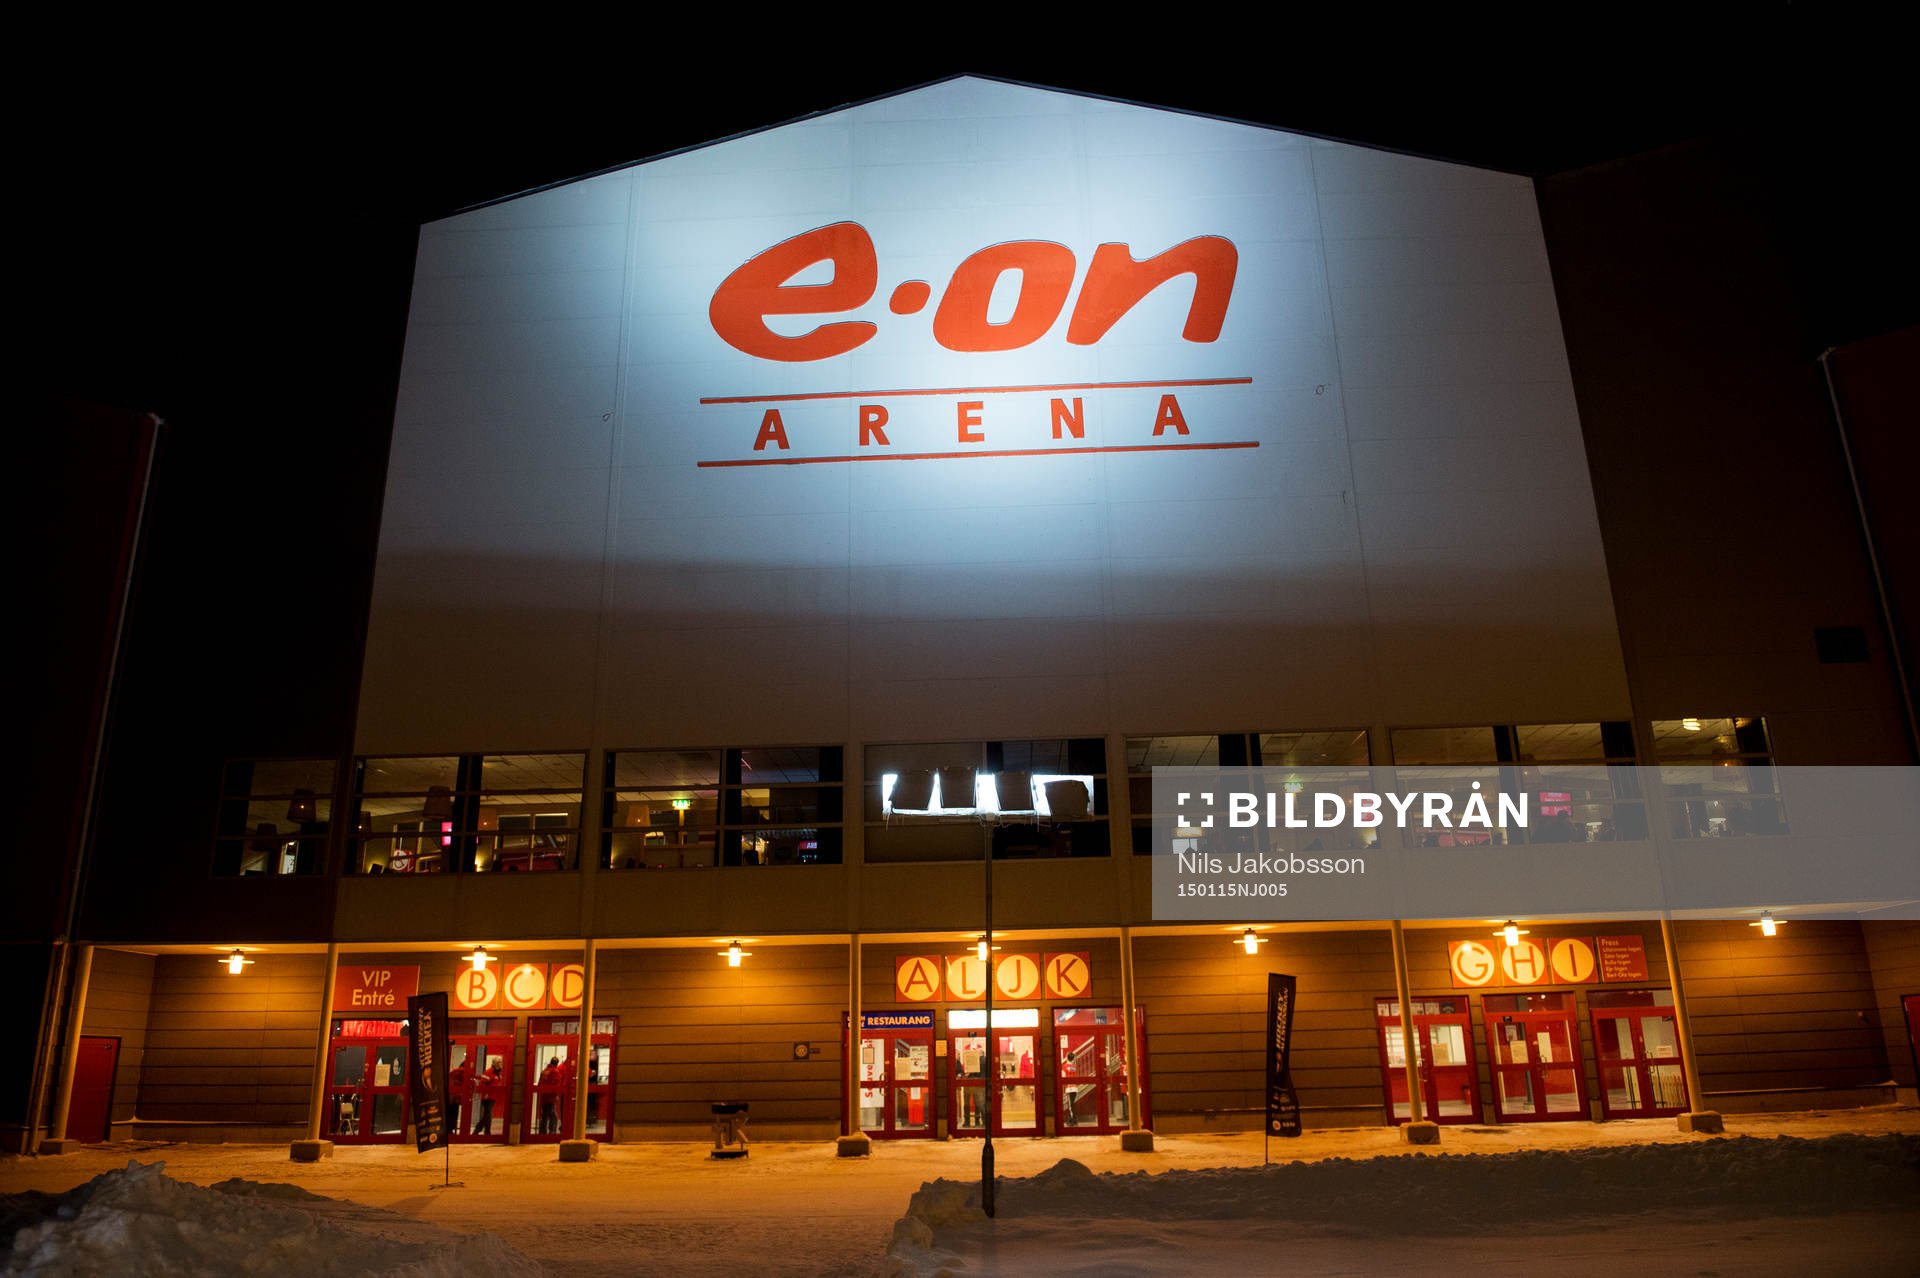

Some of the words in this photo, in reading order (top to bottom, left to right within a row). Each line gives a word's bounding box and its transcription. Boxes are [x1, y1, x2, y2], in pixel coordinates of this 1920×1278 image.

[753, 394, 1190, 451] ARENA
[362, 970, 391, 988] VIP
[904, 959, 933, 993] A
[961, 961, 977, 994] L
[1008, 959, 1022, 993] J
[1055, 958, 1081, 992] K
[1457, 946, 1489, 981] G
[1510, 946, 1537, 979] H
[1568, 944, 1578, 977] I
[352, 988, 395, 1006] Entré
[468, 971, 487, 1004] B
[509, 970, 535, 1002] C
[562, 970, 584, 1002] D
[867, 1016, 931, 1026] RESTAURANG
